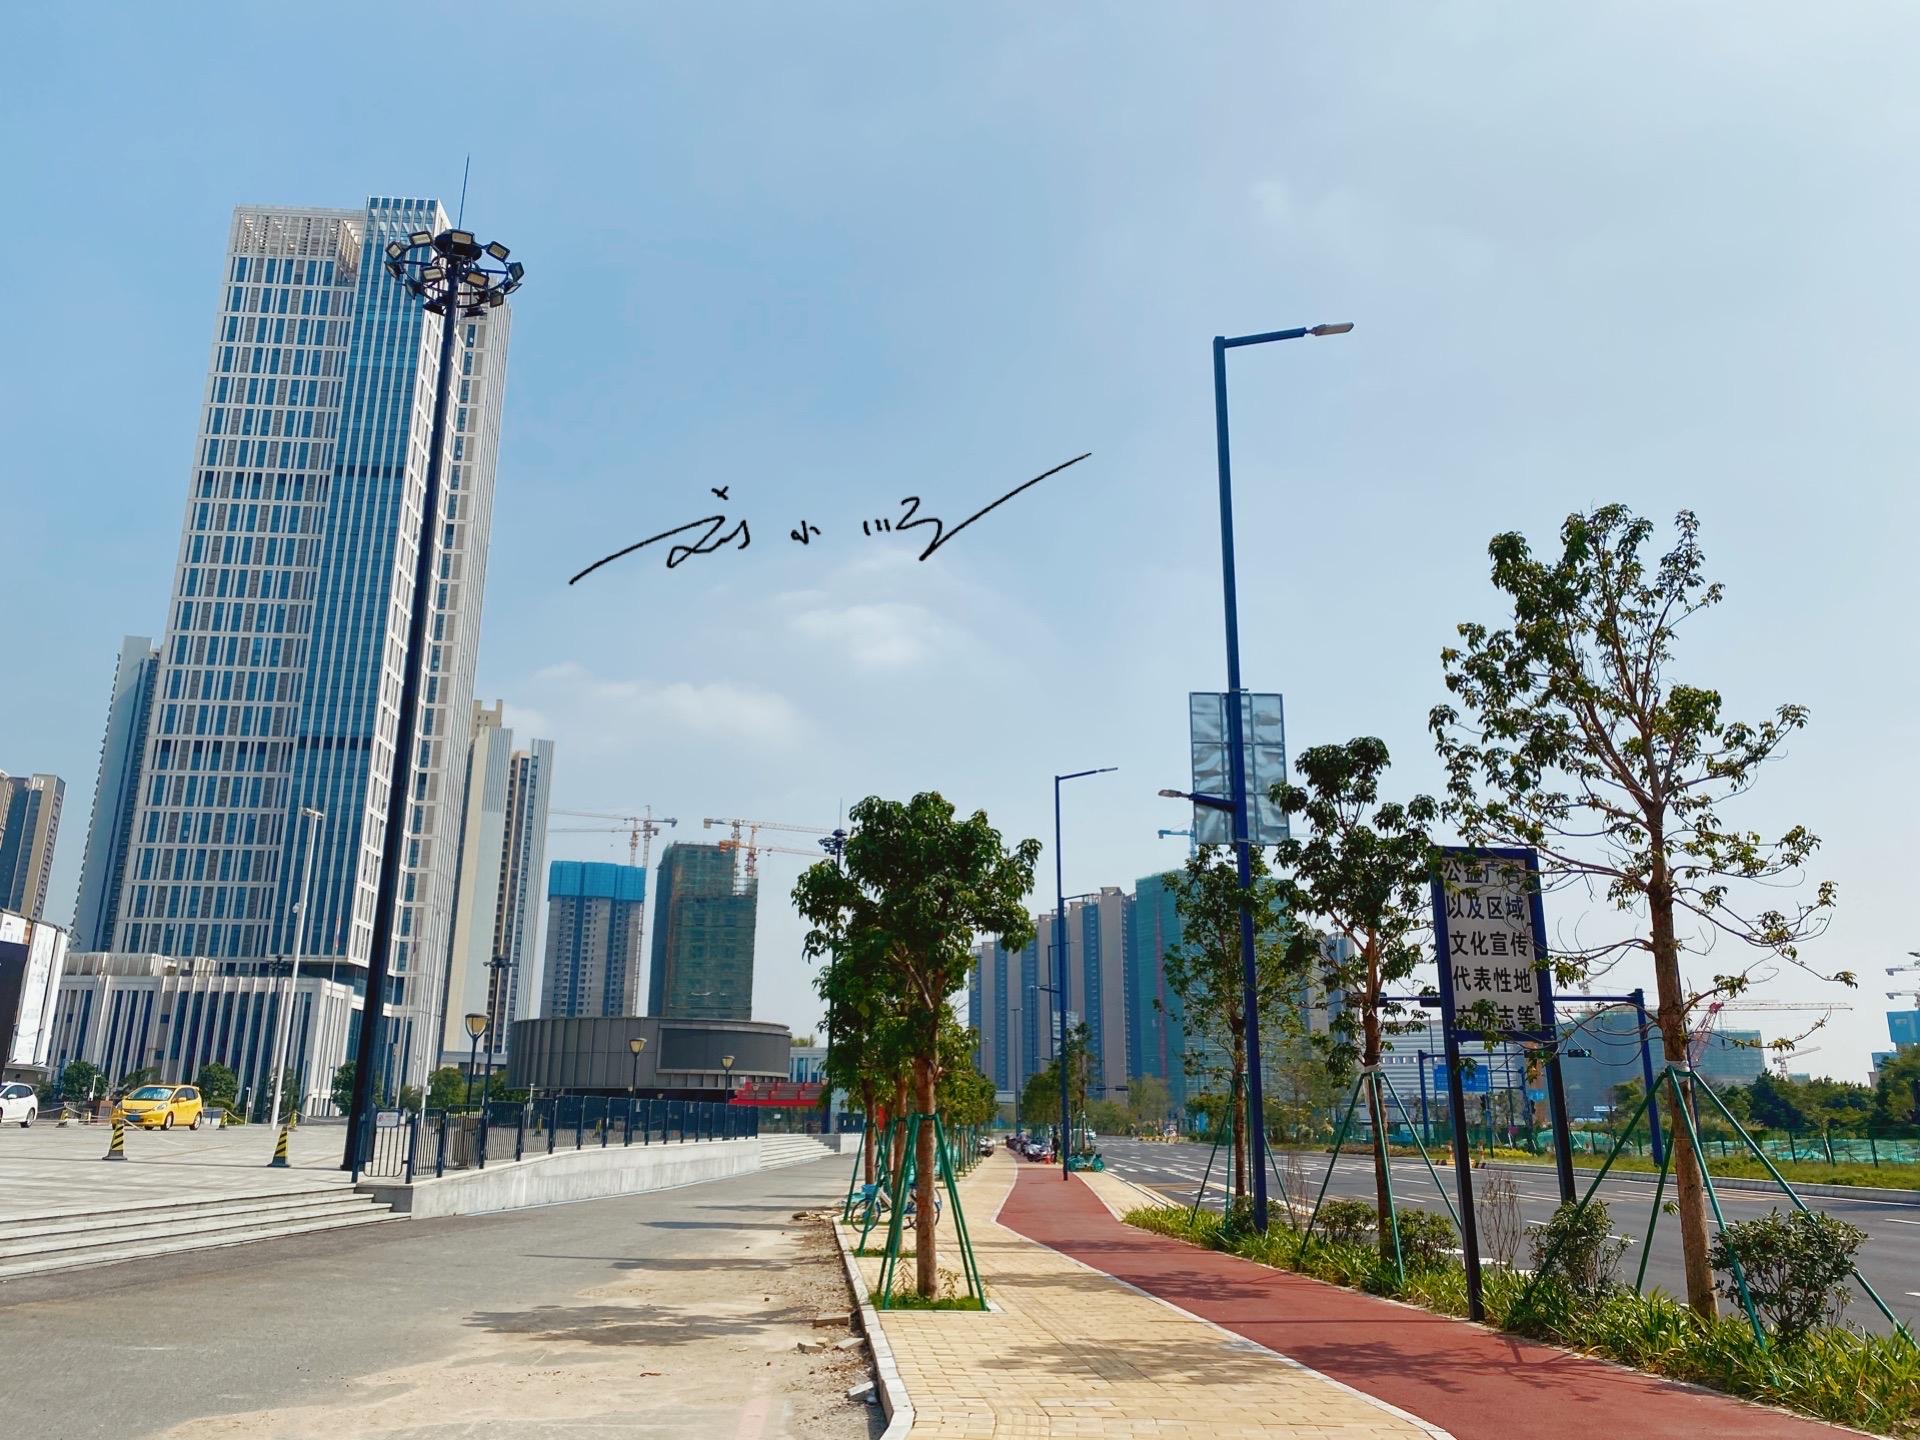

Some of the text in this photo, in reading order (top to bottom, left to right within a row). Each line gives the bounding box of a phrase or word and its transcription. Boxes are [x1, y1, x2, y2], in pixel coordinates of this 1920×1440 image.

[1446, 895, 1525, 920] 以及区域
[1450, 930, 1528, 957] 文化宣传
[1453, 965, 1533, 993] 代表性地
